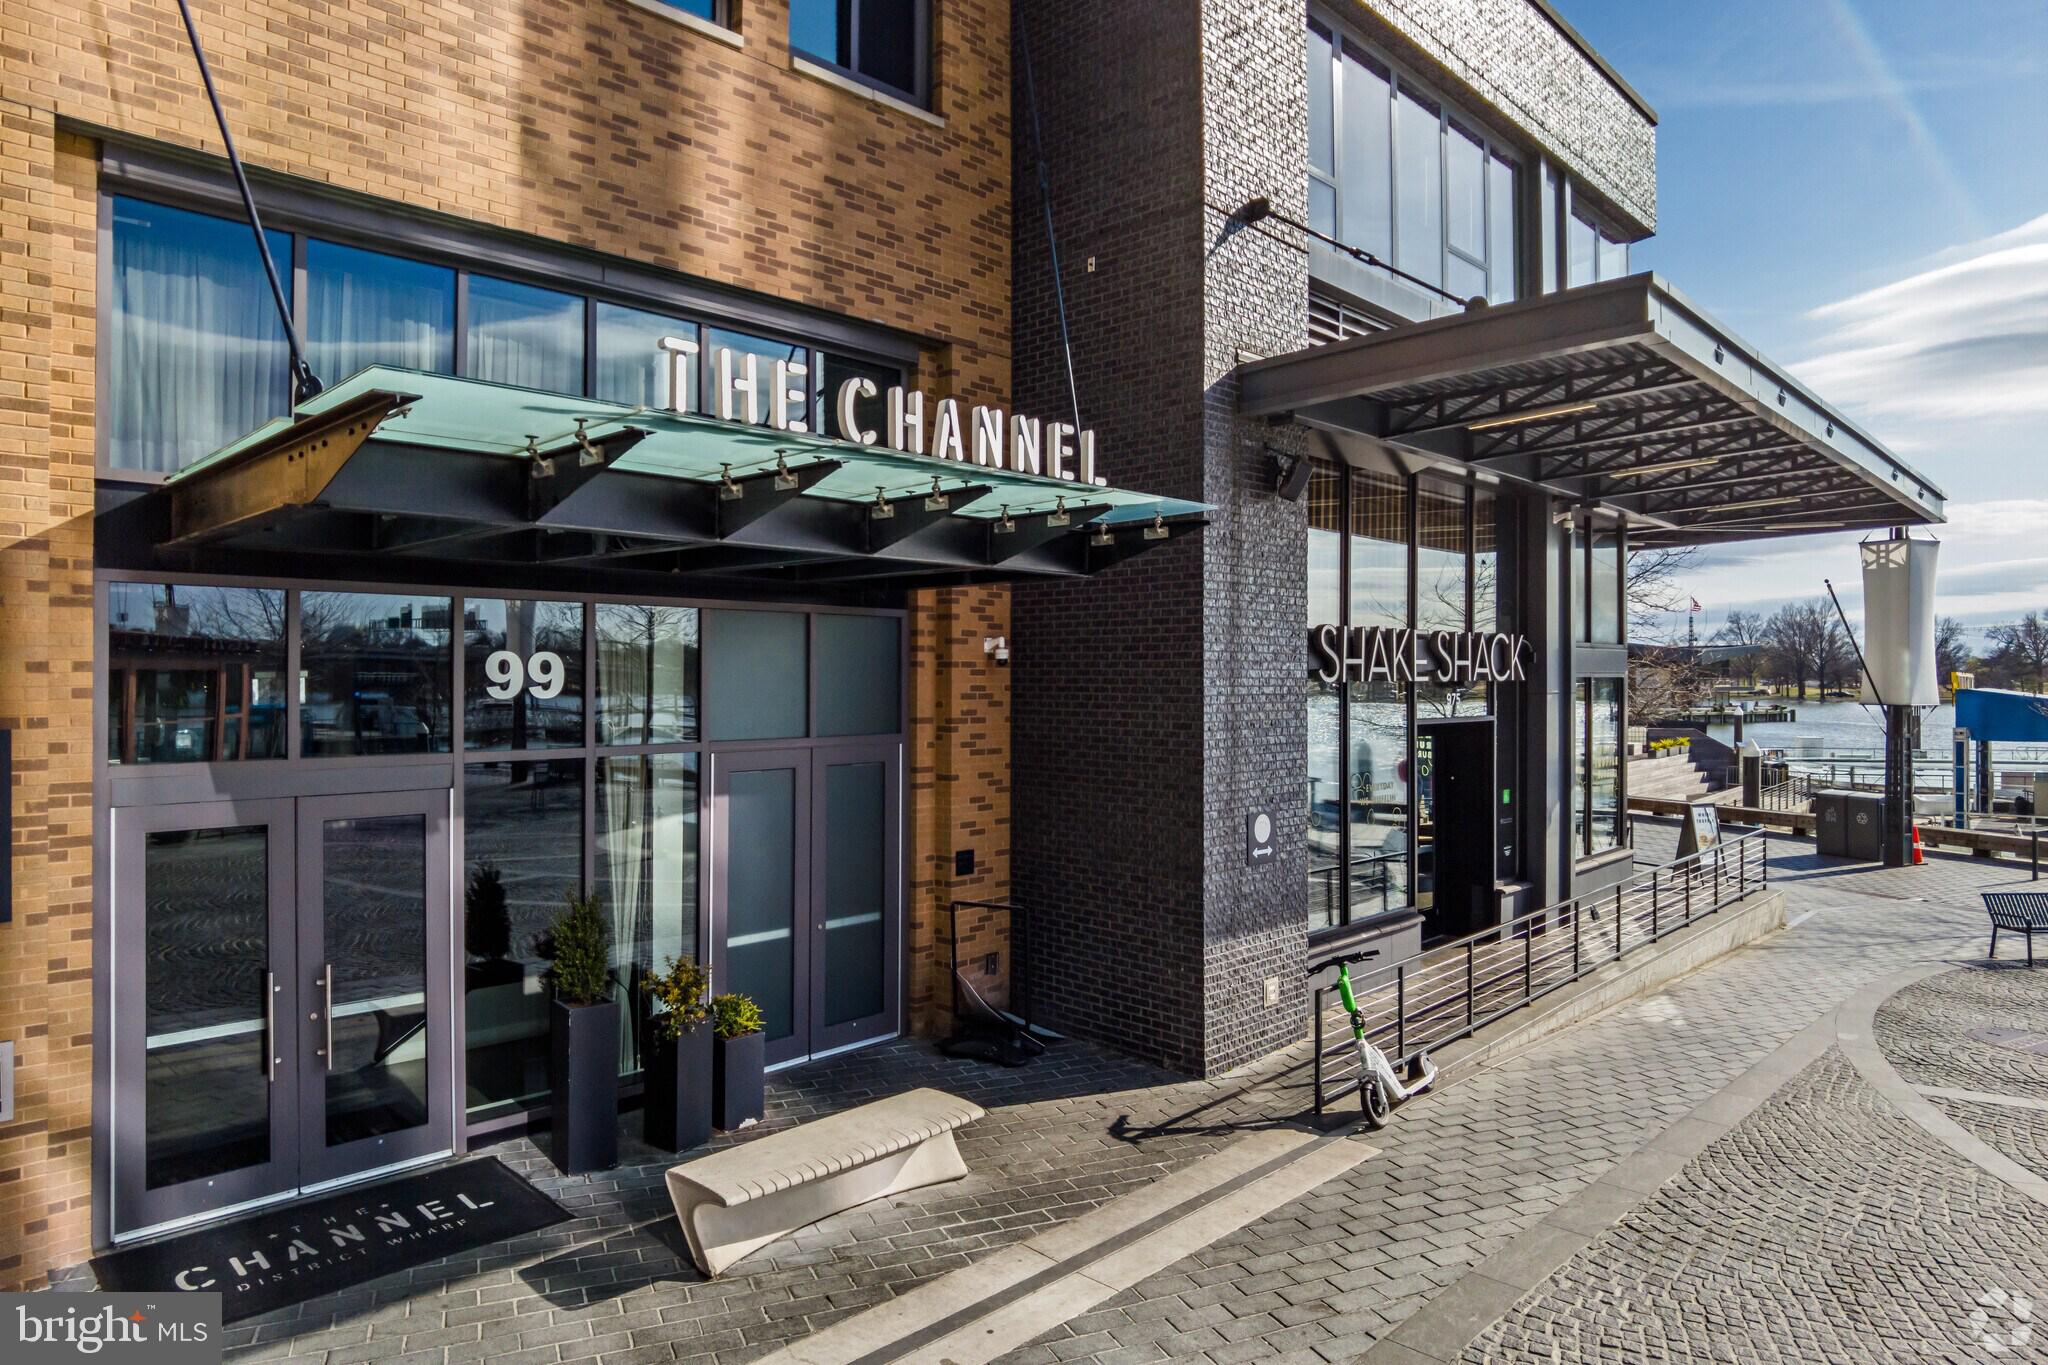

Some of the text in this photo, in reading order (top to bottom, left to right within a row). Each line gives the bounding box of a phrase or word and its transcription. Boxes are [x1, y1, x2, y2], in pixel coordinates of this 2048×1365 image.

[657, 336, 1107, 487] THE CHANNEL
[484, 650, 565, 700] 99
[1316, 624, 1526, 683] SHAKE SHACK
[1446, 692, 1461, 706] 975
[174, 1192, 495, 1291] CHANNEL
[291, 1206, 369, 1233] THE
[236, 1218, 467, 1292] DISTRICT WHARF
